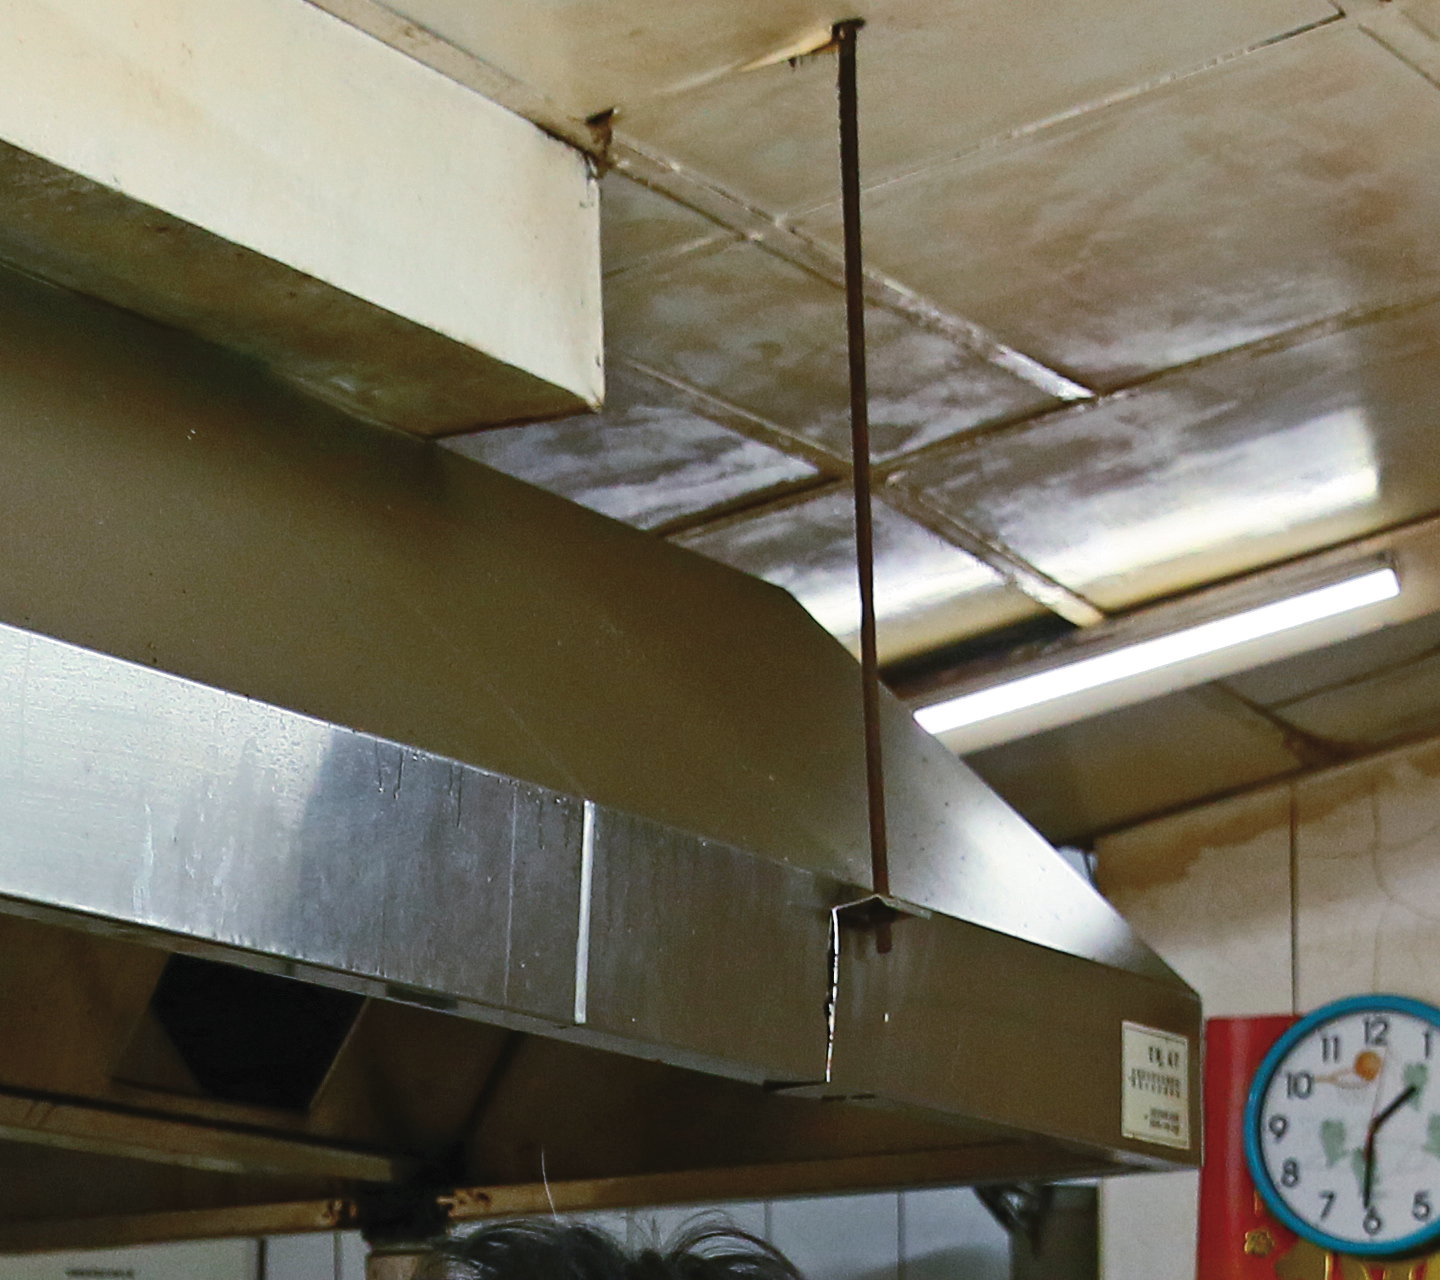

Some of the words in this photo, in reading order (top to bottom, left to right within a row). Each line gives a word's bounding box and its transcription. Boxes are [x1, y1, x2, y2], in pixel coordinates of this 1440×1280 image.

[1364, 1017, 1388, 1047] 12
[1424, 1032, 1432, 1059] 1
[1322, 1036, 1338, 1061] 11
[1286, 1072, 1313, 1098] 10
[1269, 1114, 1287, 1140] 9
[1282, 1160, 1299, 1187] 8
[1320, 1192, 1335, 1219] 7
[1413, 1192, 1430, 1221] 5
[1363, 1205, 1381, 1235] 6
